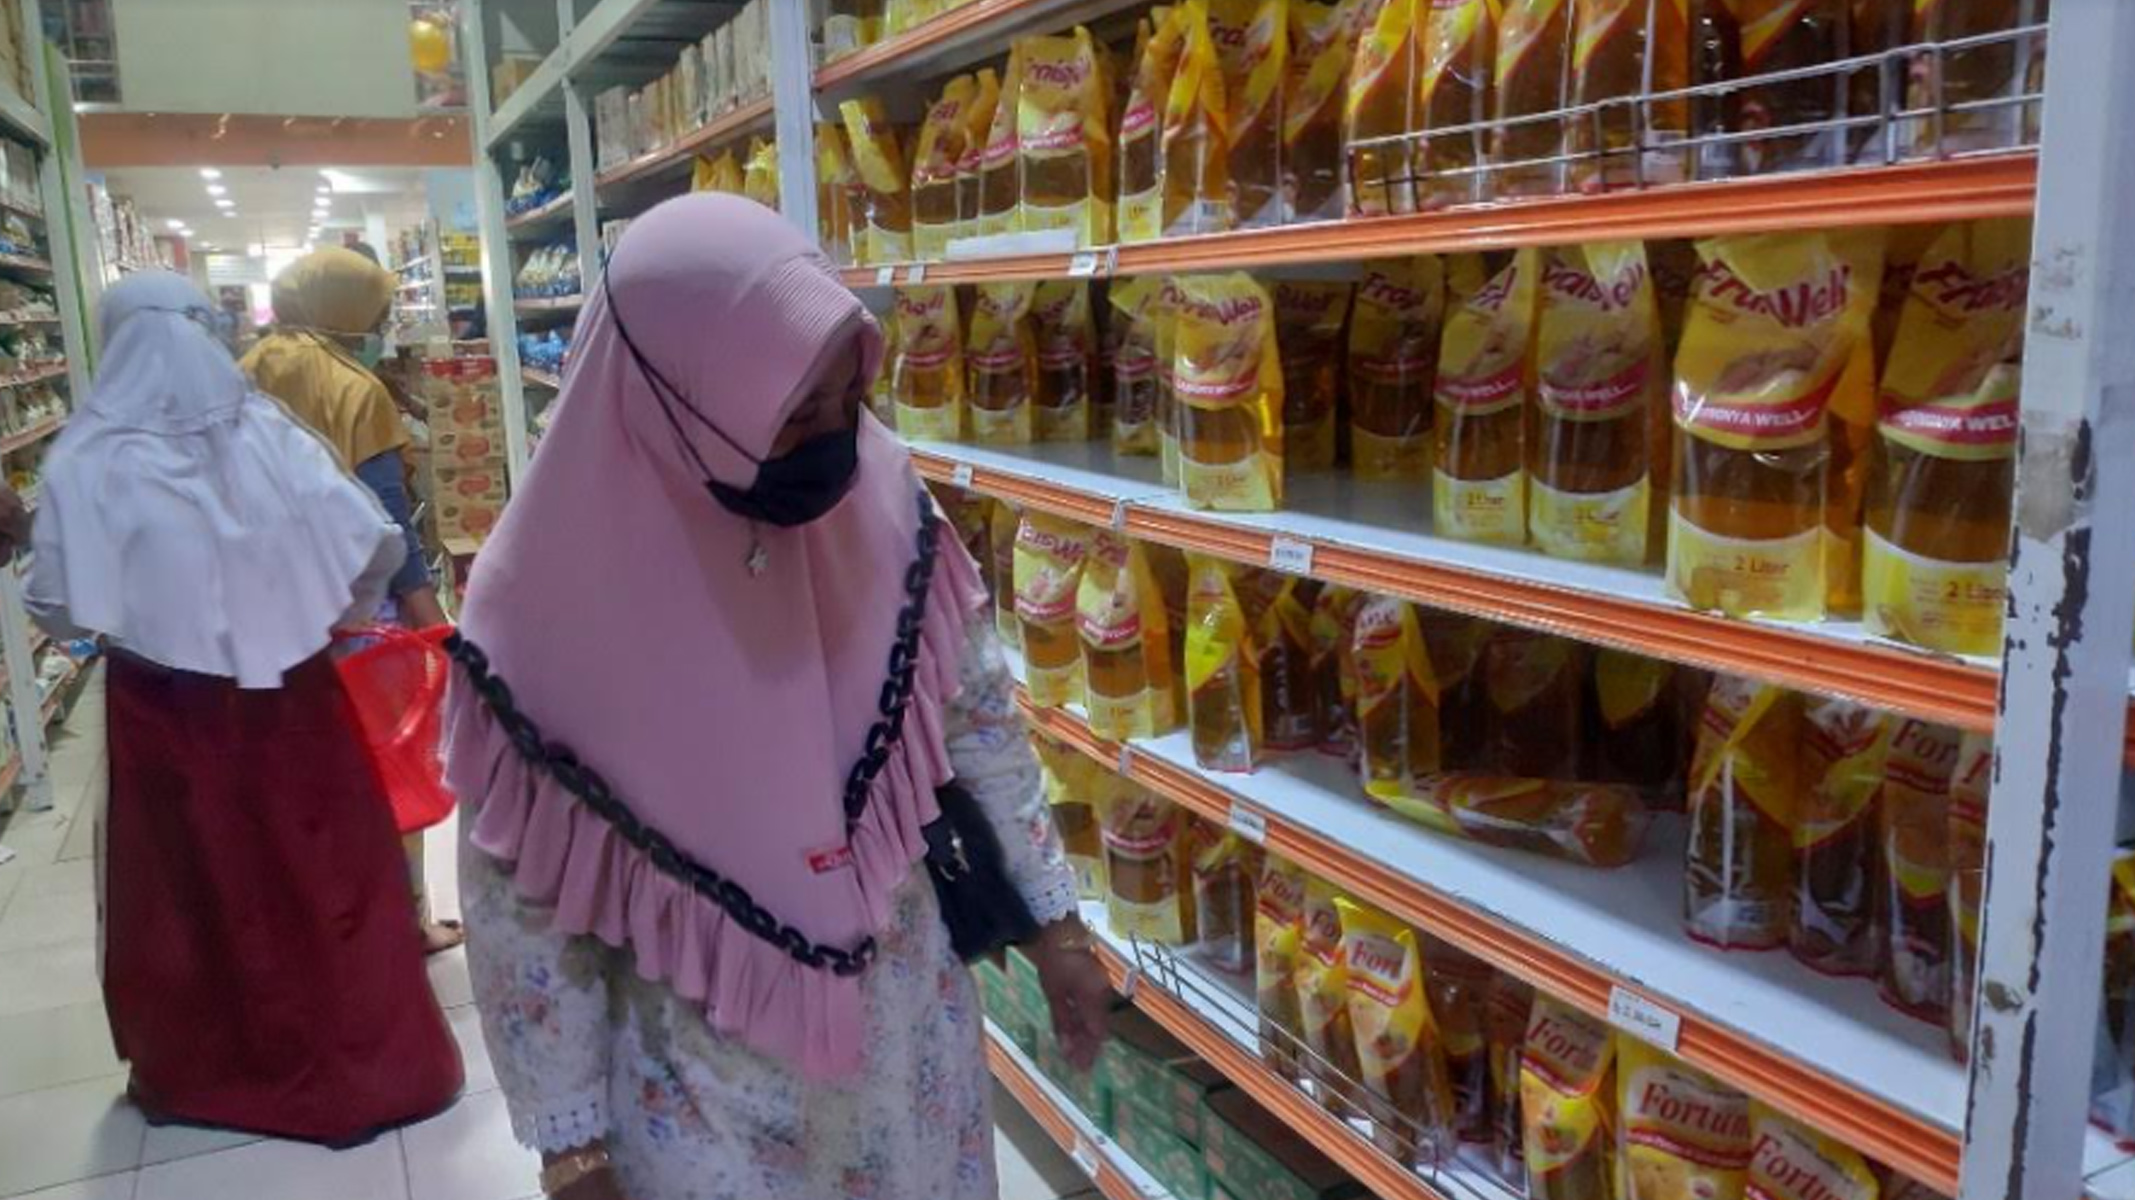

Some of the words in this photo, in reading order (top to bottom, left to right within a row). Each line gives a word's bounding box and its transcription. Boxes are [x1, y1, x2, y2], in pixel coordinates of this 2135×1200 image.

[1735, 555, 1745, 571] 2
[1751, 558, 1791, 574] Liter
[1946, 580, 1959, 598] 2
